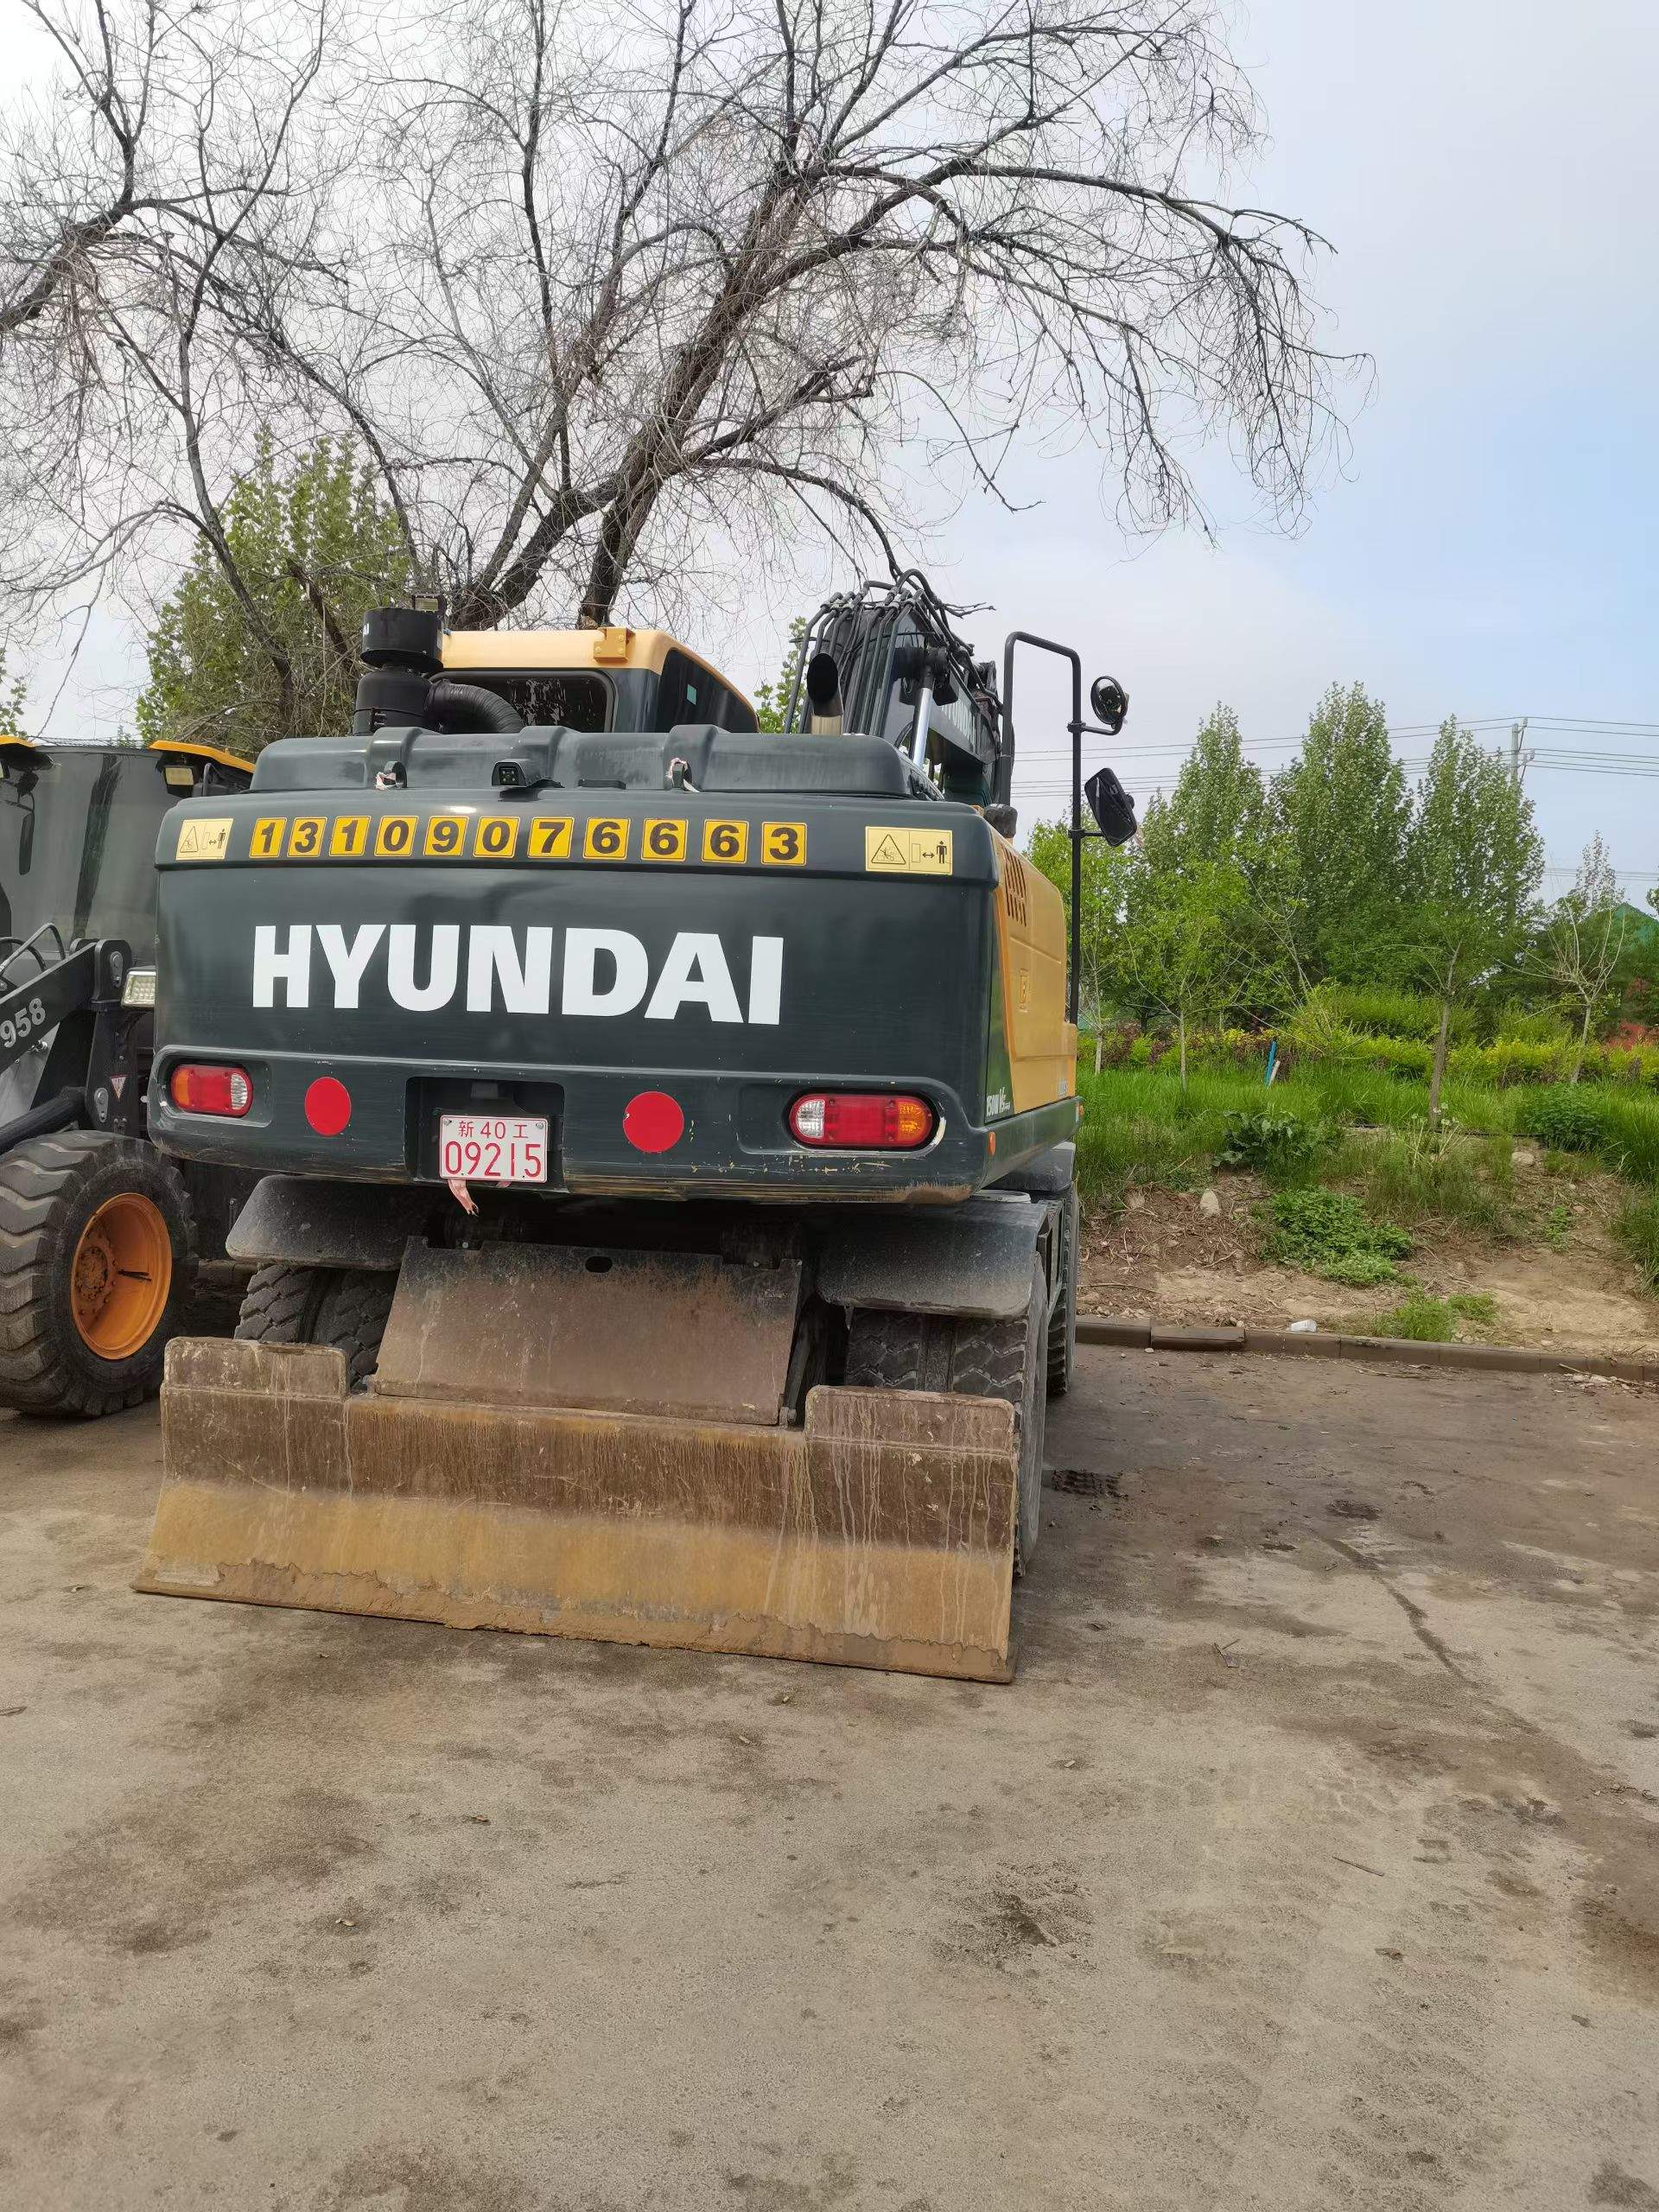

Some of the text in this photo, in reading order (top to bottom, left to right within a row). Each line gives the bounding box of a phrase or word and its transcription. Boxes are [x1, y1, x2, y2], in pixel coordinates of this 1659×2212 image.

[260, 820, 799, 861] 13109076663
[252, 924, 784, 1025] HYUNDAI
[0, 998, 46, 1048] 958
[445, 1141, 541, 1178] 09215
